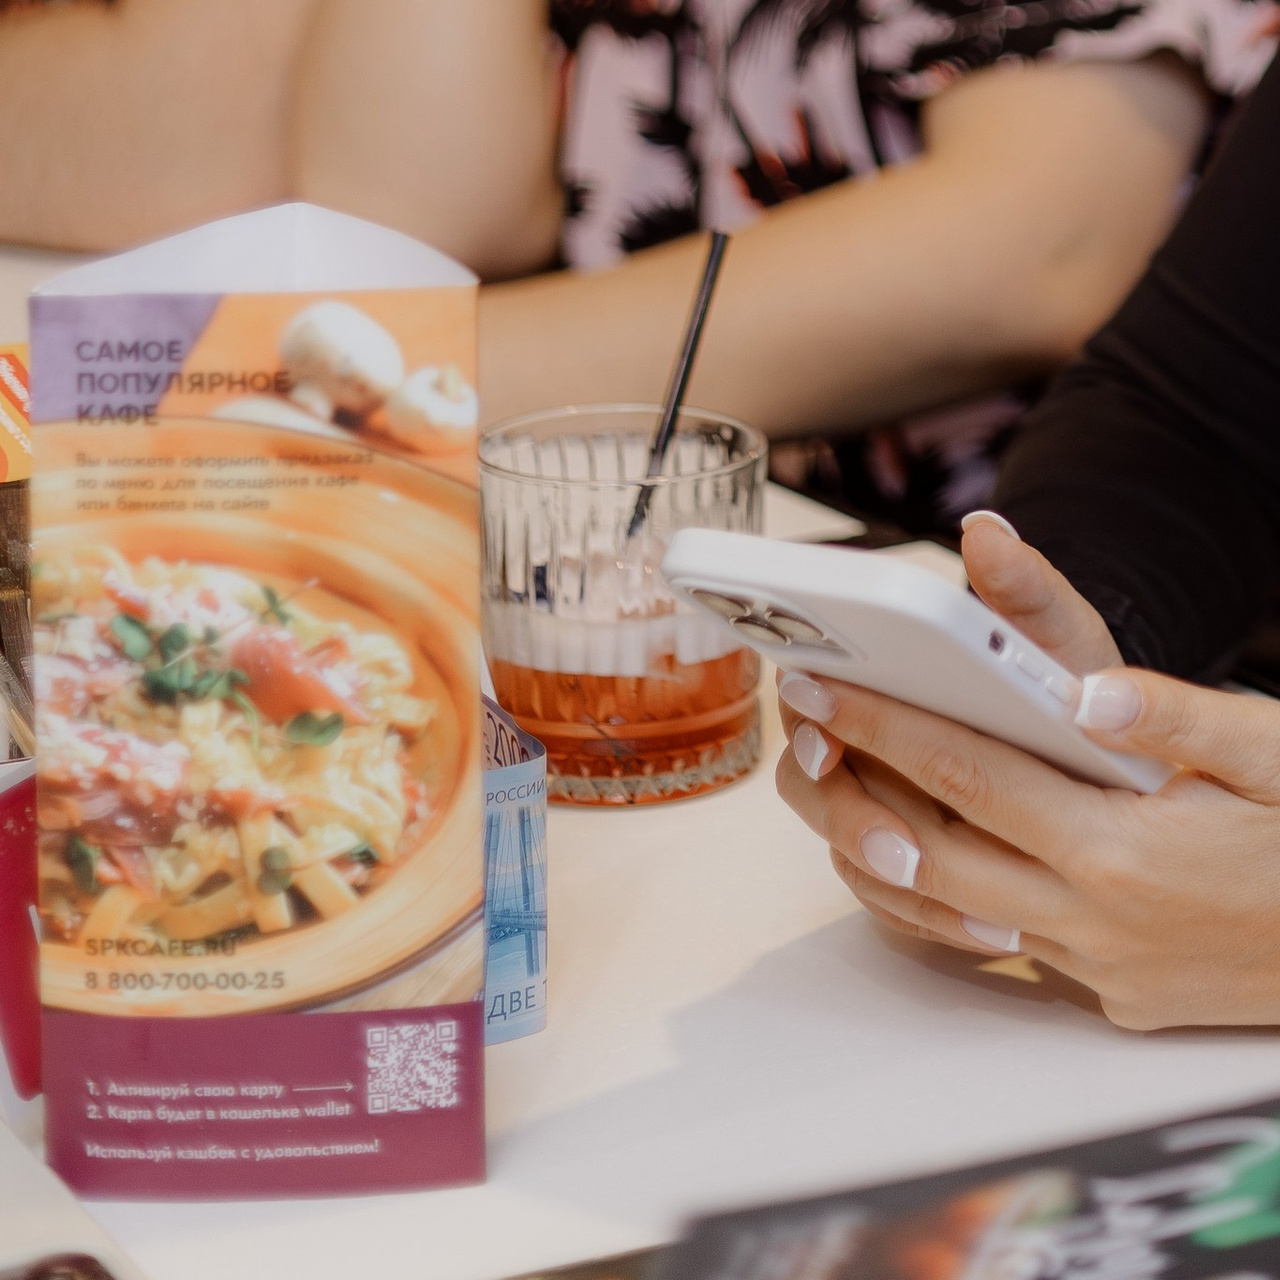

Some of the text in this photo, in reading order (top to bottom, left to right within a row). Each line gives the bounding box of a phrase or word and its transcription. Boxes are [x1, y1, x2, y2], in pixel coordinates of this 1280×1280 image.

[75, 339, 184, 363] САМОЕ
[75, 370, 291, 395] ПОПУЛЯРНОЕ
[75, 403, 159, 426] КАФЕ
[75, 478, 98, 490] по
[104, 478, 154, 491] меню
[160, 477, 197, 492] для
[203, 476, 310, 491] посещения
[193, 499, 216, 511] на
[221, 494, 270, 511] сайте
[486, 778, 546, 807] РОССИИ
[84, 937, 237, 957] SPKCAFE.RU
[84, 971, 285, 991] 8 800-700-00-25
[486, 985, 536, 1025] ДВЕ
[85, 1080, 285, 1100] 1. Активируй свою карту
[86, 1100, 353, 1124] 2. Карта будет в кошельке wallet
[85, 1138, 380, 1163] Используй кэшбек с удовольствием!
